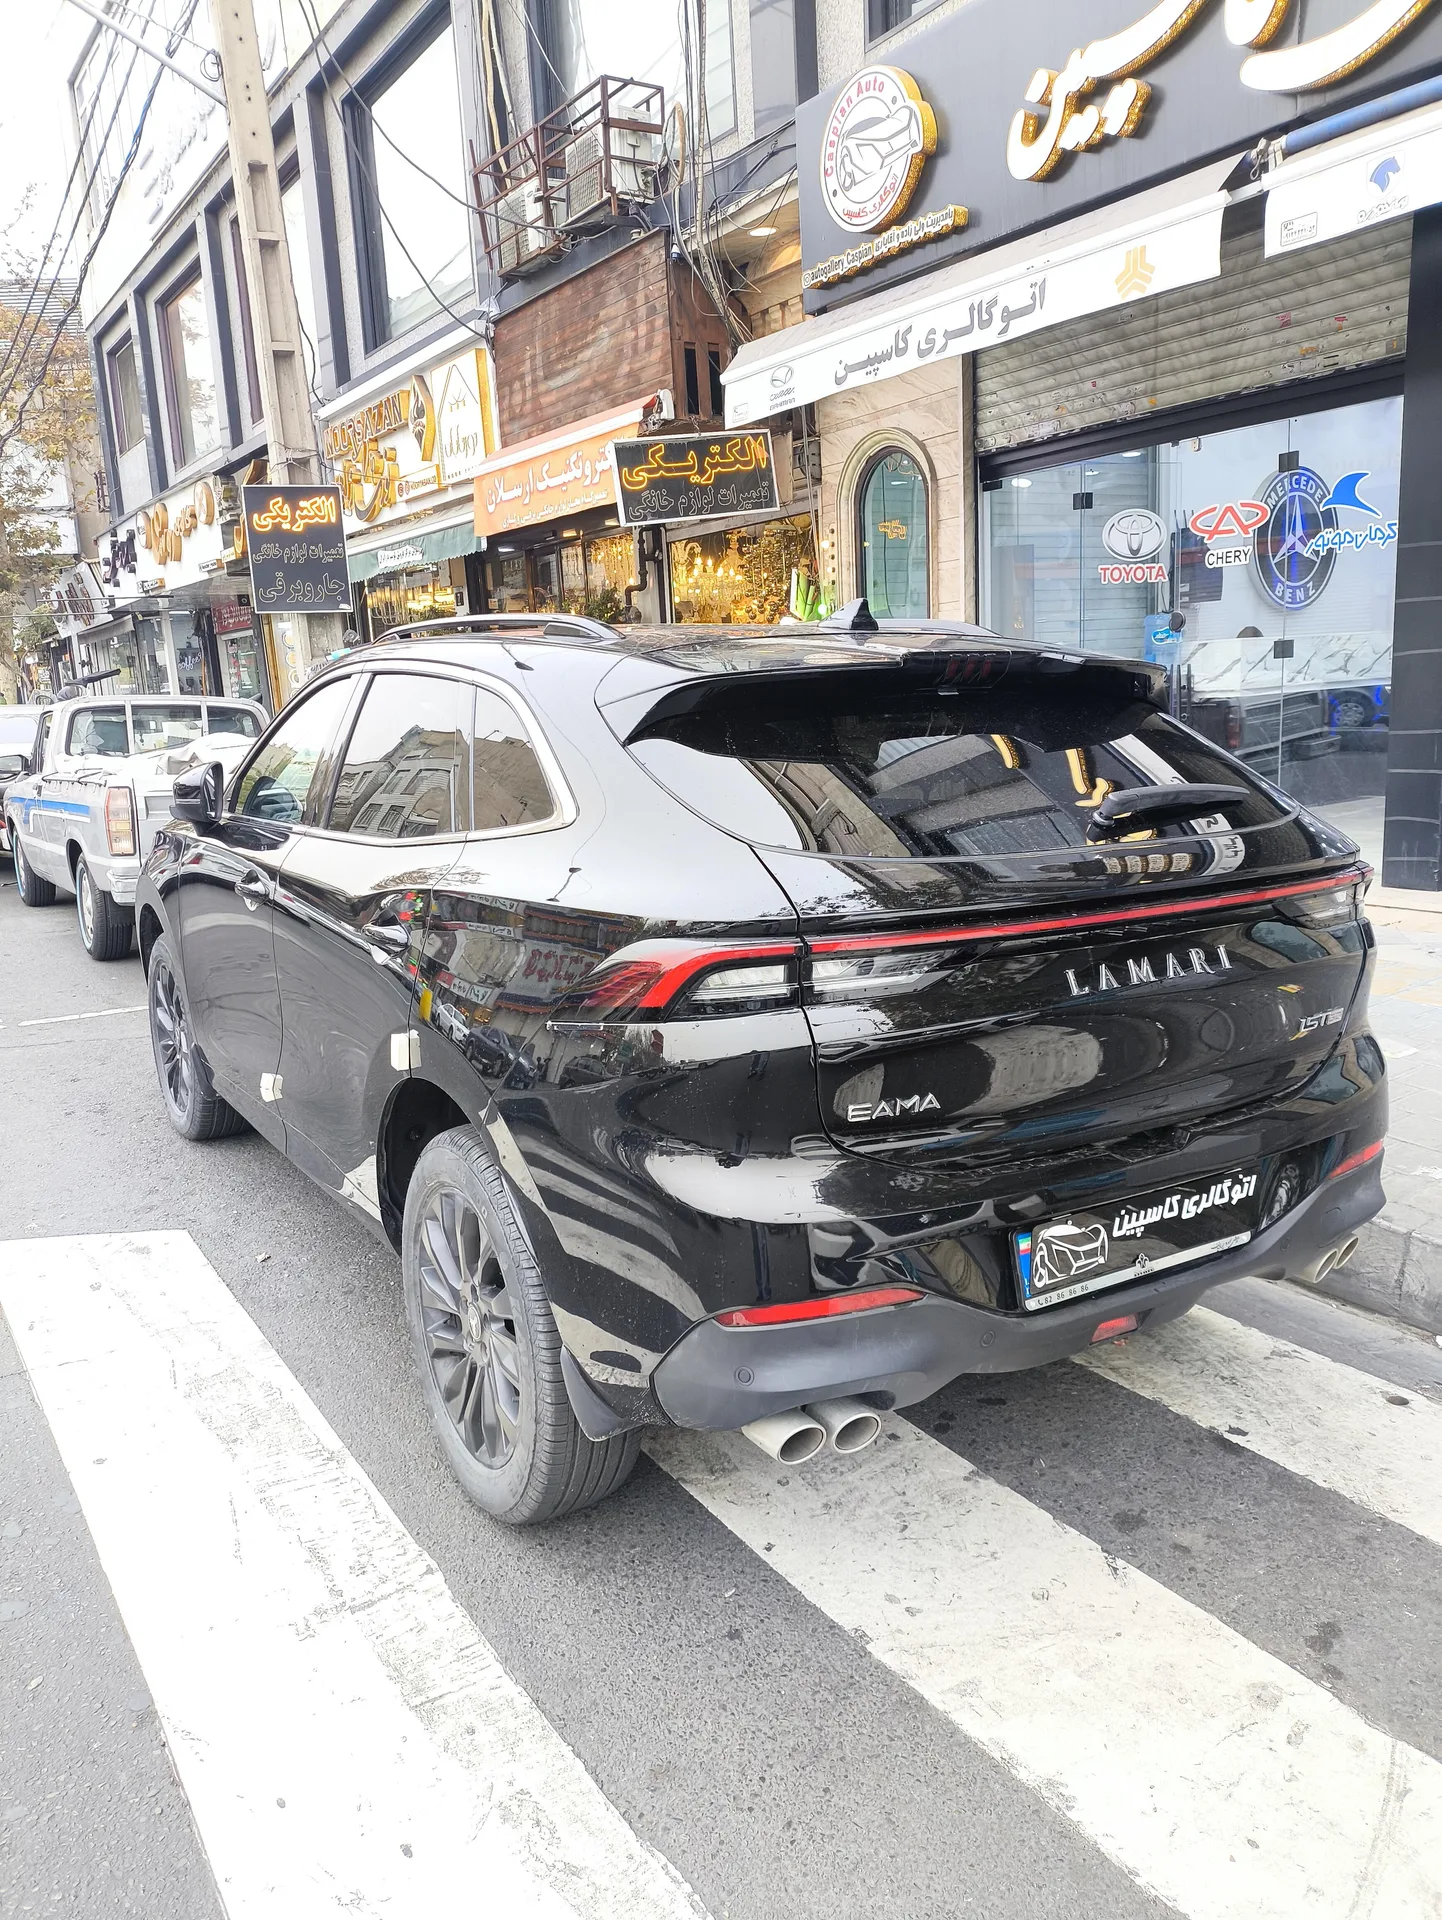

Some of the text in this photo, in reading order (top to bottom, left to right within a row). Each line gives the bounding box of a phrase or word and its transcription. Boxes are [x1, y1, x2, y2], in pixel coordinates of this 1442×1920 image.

[824, 75, 885, 177] Caspian Auto
[834, 324, 913, 386] کاسپین
[622, 435, 768, 490] الکتریکی
[486, 467, 534, 514] ارسلان
[628, 481, 770, 521] تعمیرات لوازم خانگی
[252, 495, 336, 532] الکتریکی
[252, 542, 283, 564] خانگی
[283, 542, 308, 564] لوازم
[309, 542, 345, 563] تعمیرات
[1305, 522, 1398, 555] کرمان موتور
[1099, 565, 1167, 583] TOYOTA
[1206, 549, 1252, 567] CHERY
[1274, 580, 1317, 602] BENZ
[1063, 944, 1233, 997] LAMARI
[847, 1092, 942, 1123] EAMA
[1111, 1194, 1182, 1239] کاسپین
[1044, 1283, 1090, 1305] 82 86 86 86
